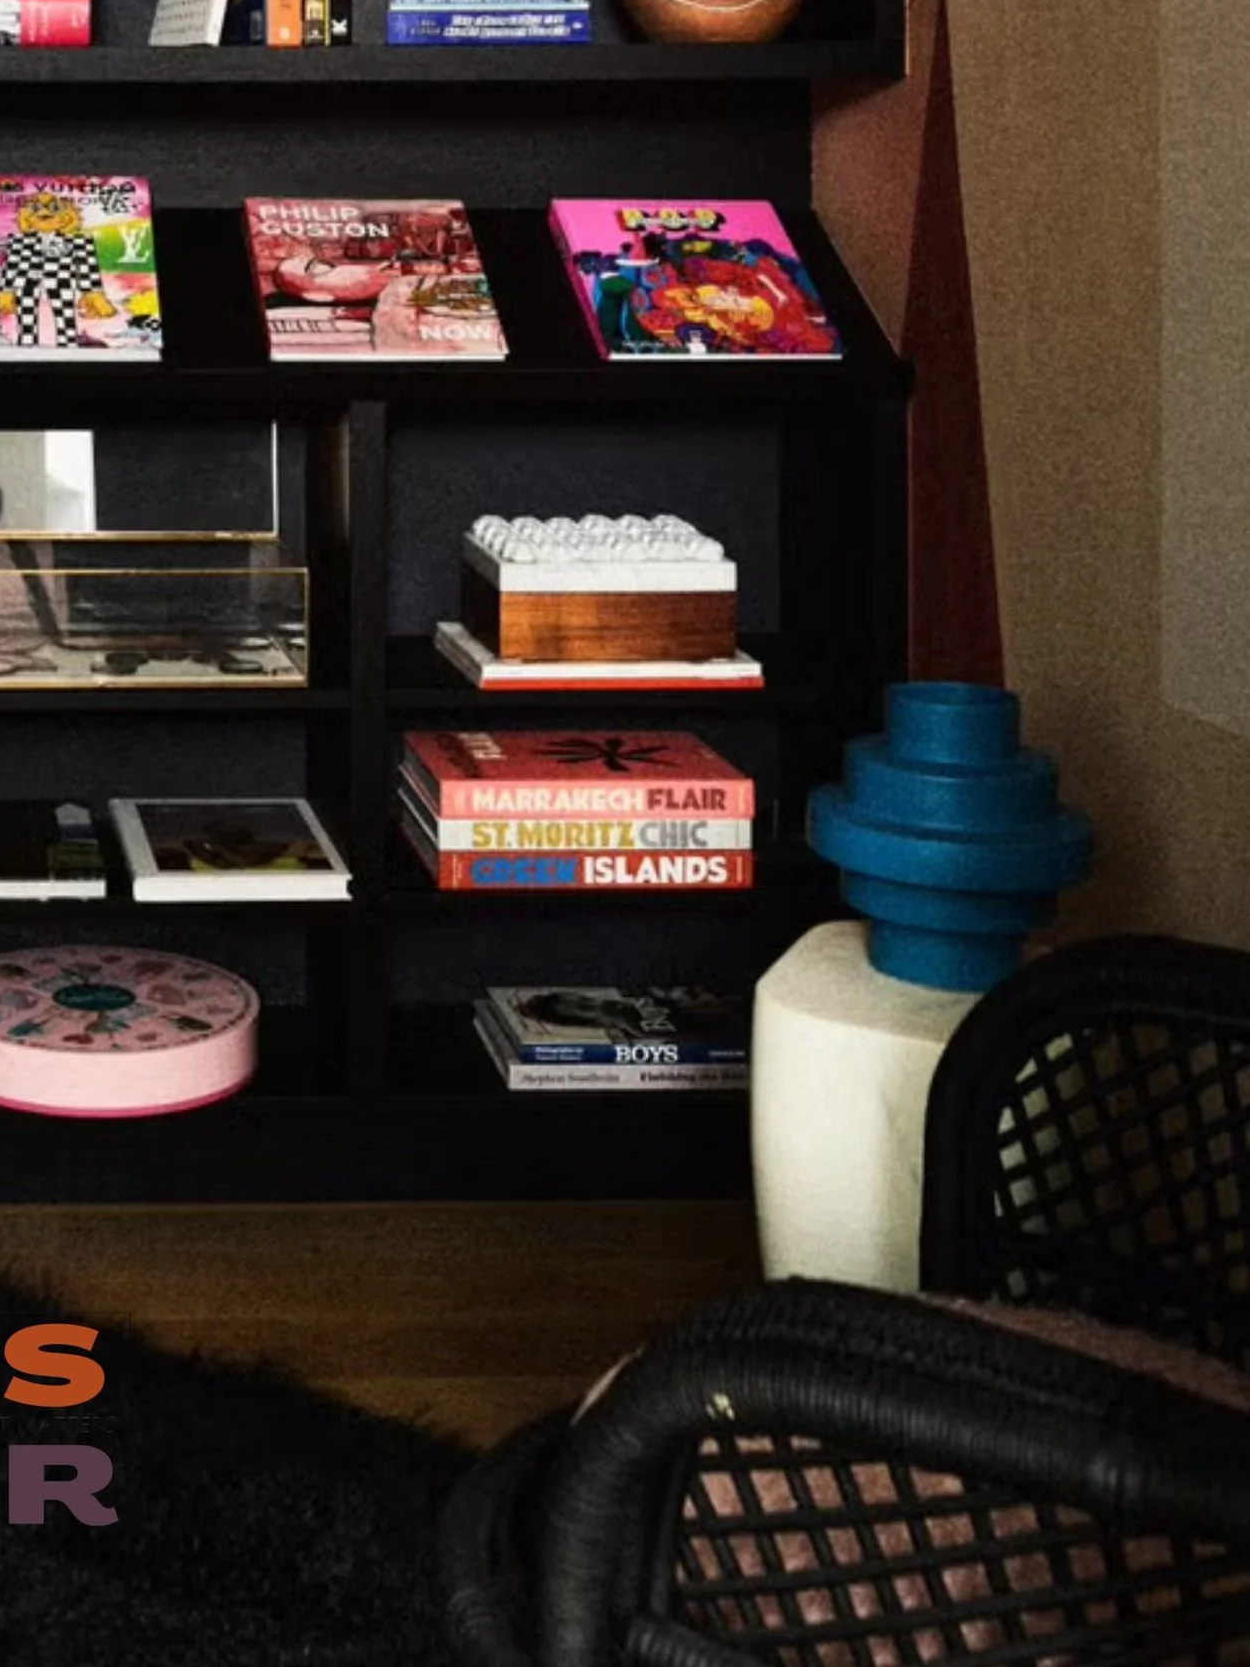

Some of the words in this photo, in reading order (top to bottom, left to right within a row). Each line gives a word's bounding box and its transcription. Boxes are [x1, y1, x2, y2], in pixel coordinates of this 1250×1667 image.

[258, 204, 360, 221] PHILIP
[261, 221, 390, 238] GUSTON
[420, 325, 493, 341] NOW
[471, 787, 646, 811] MARRAKECH
[647, 788, 727, 811] FLAIR
[471, 821, 513, 848] ST.
[515, 821, 636, 848] MORITZ
[637, 821, 709, 848] CHIC
[583, 856, 728, 884] ISLANDS
[615, 1044, 679, 1064] BOYS
